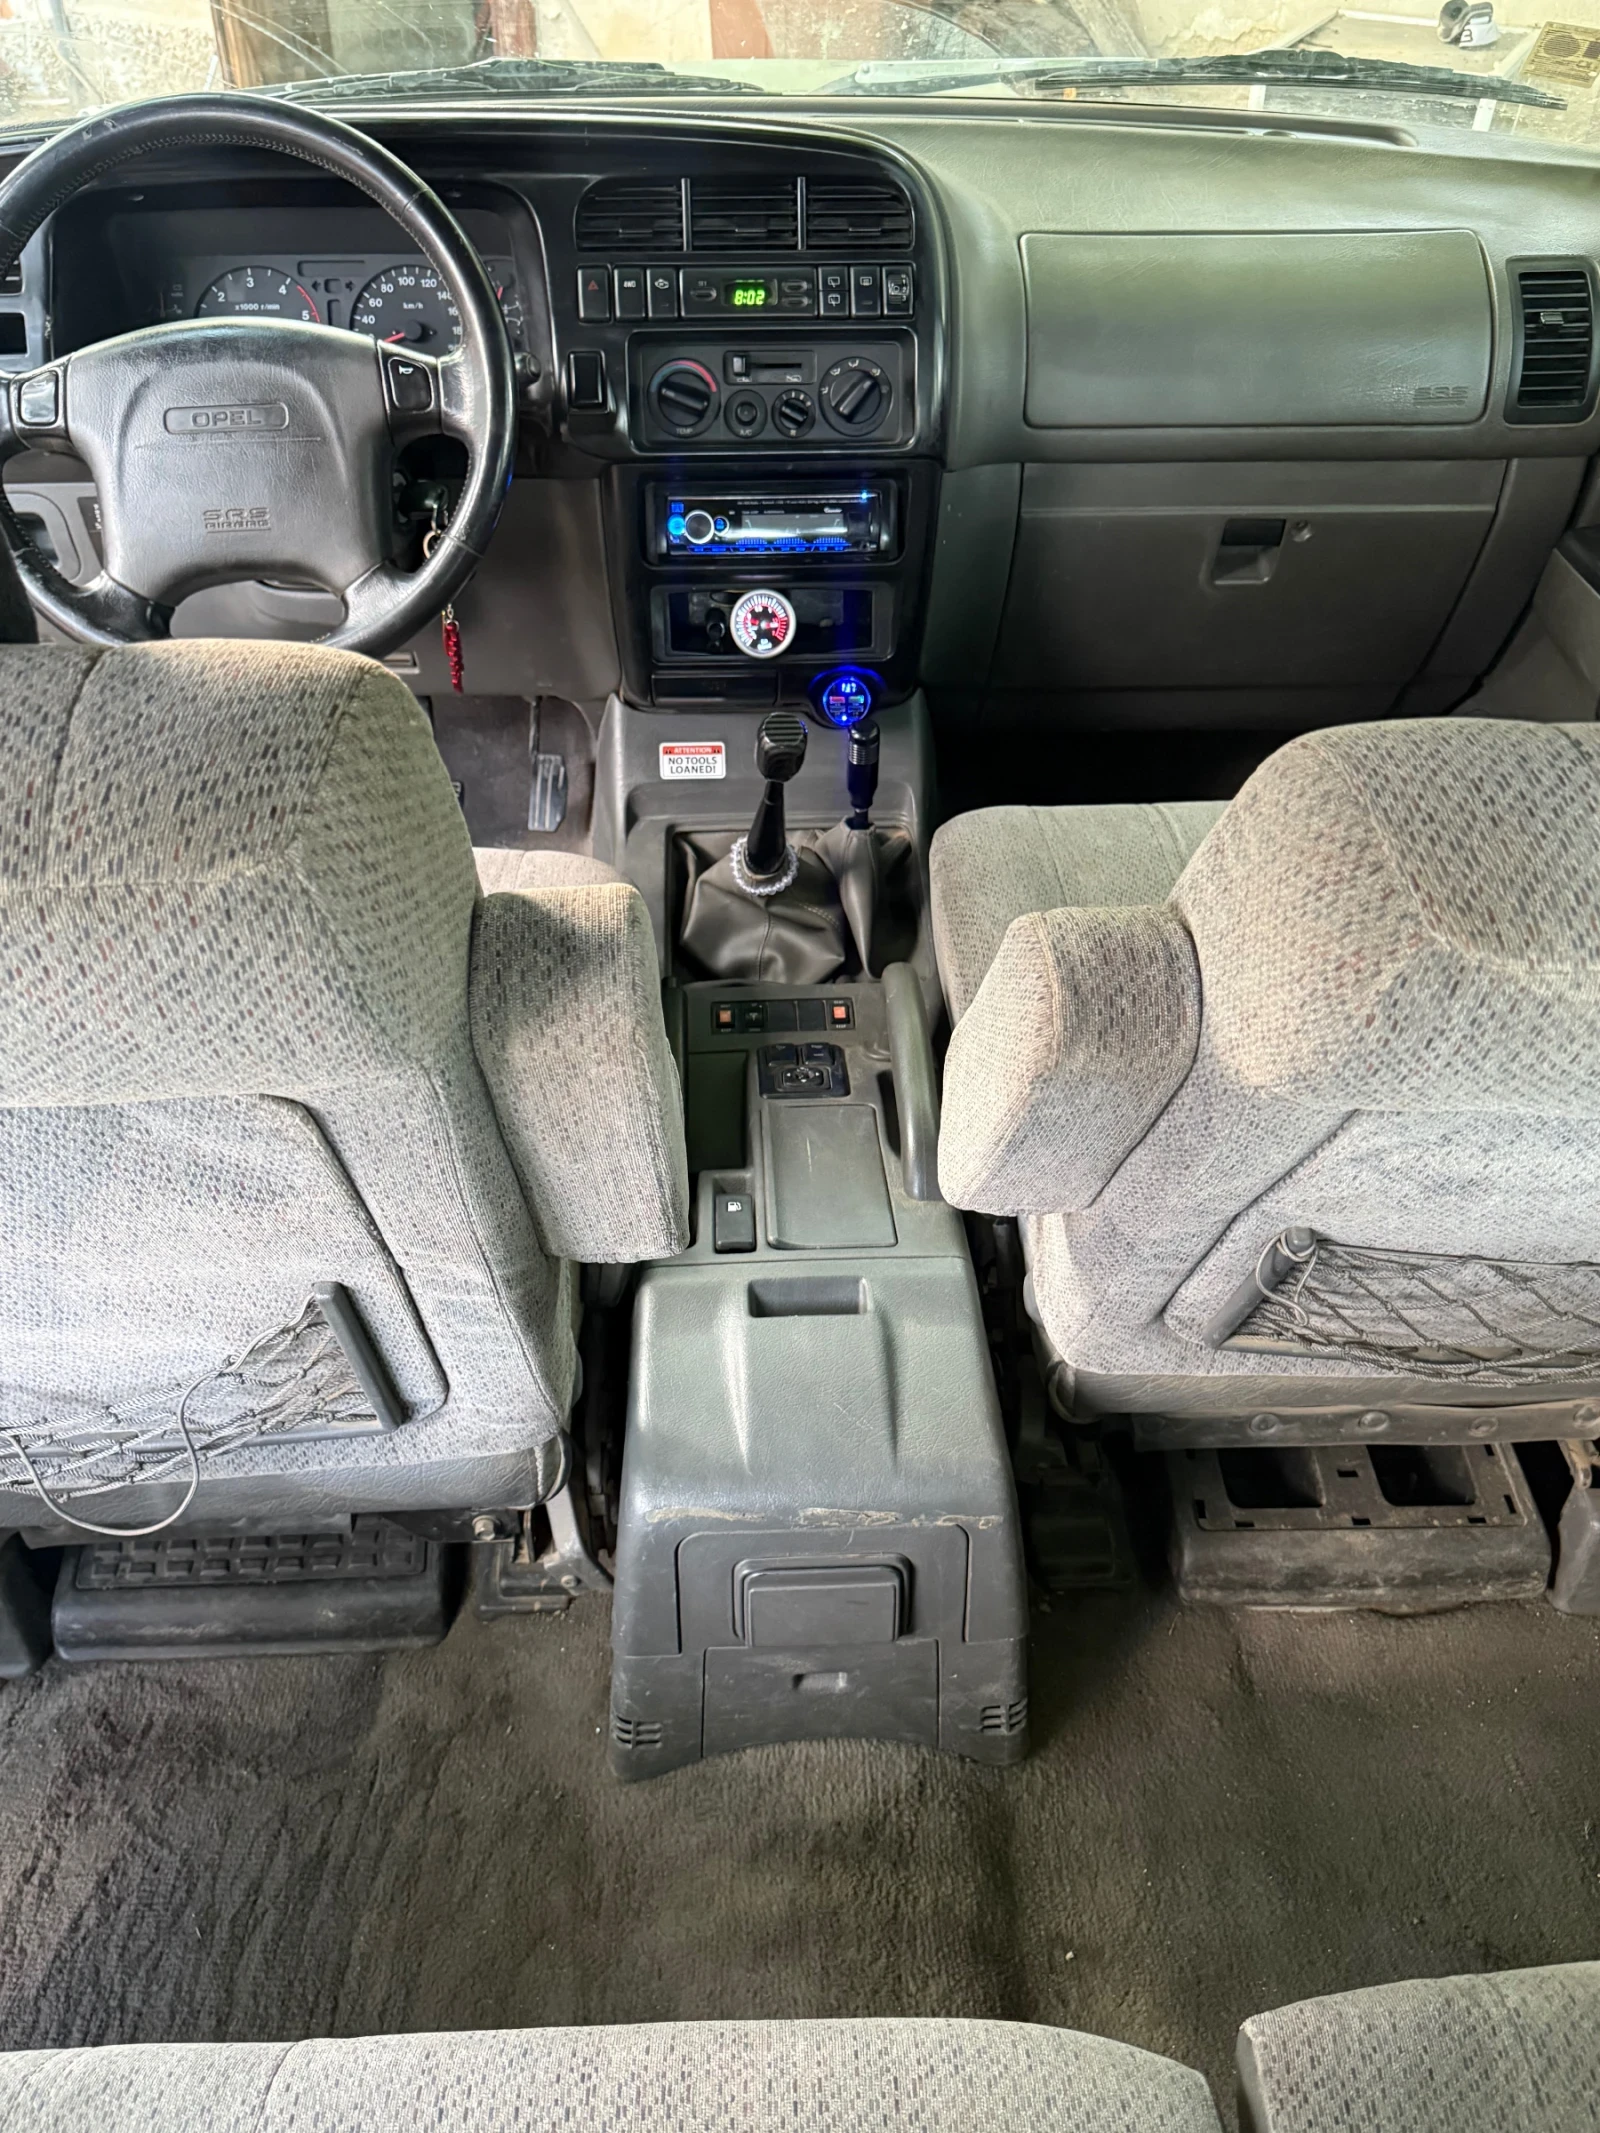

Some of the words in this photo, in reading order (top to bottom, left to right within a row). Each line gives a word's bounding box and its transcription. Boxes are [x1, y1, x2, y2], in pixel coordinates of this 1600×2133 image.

[246, 277, 255, 288] 3
[398, 277, 415, 286] 100
[421, 279, 437, 288] 120
[279, 284, 288, 295] 4
[381, 283, 394, 293] 80
[218, 292, 226, 302] 2
[437, 291, 450, 300] 14
[734, 289, 765, 306] 8:02
[369, 298, 382, 308] 60
[302, 310, 310, 320] 5
[448, 307, 459, 316] 16
[362, 315, 376, 324] 40
[452, 326, 462, 335] 18
[192, 410, 262, 427] OPEL
[203, 507, 270, 521] SRS
[668, 757, 684, 765] NO
[685, 756, 717, 765] TOOLS
[670, 765, 716, 774] LOANED!
